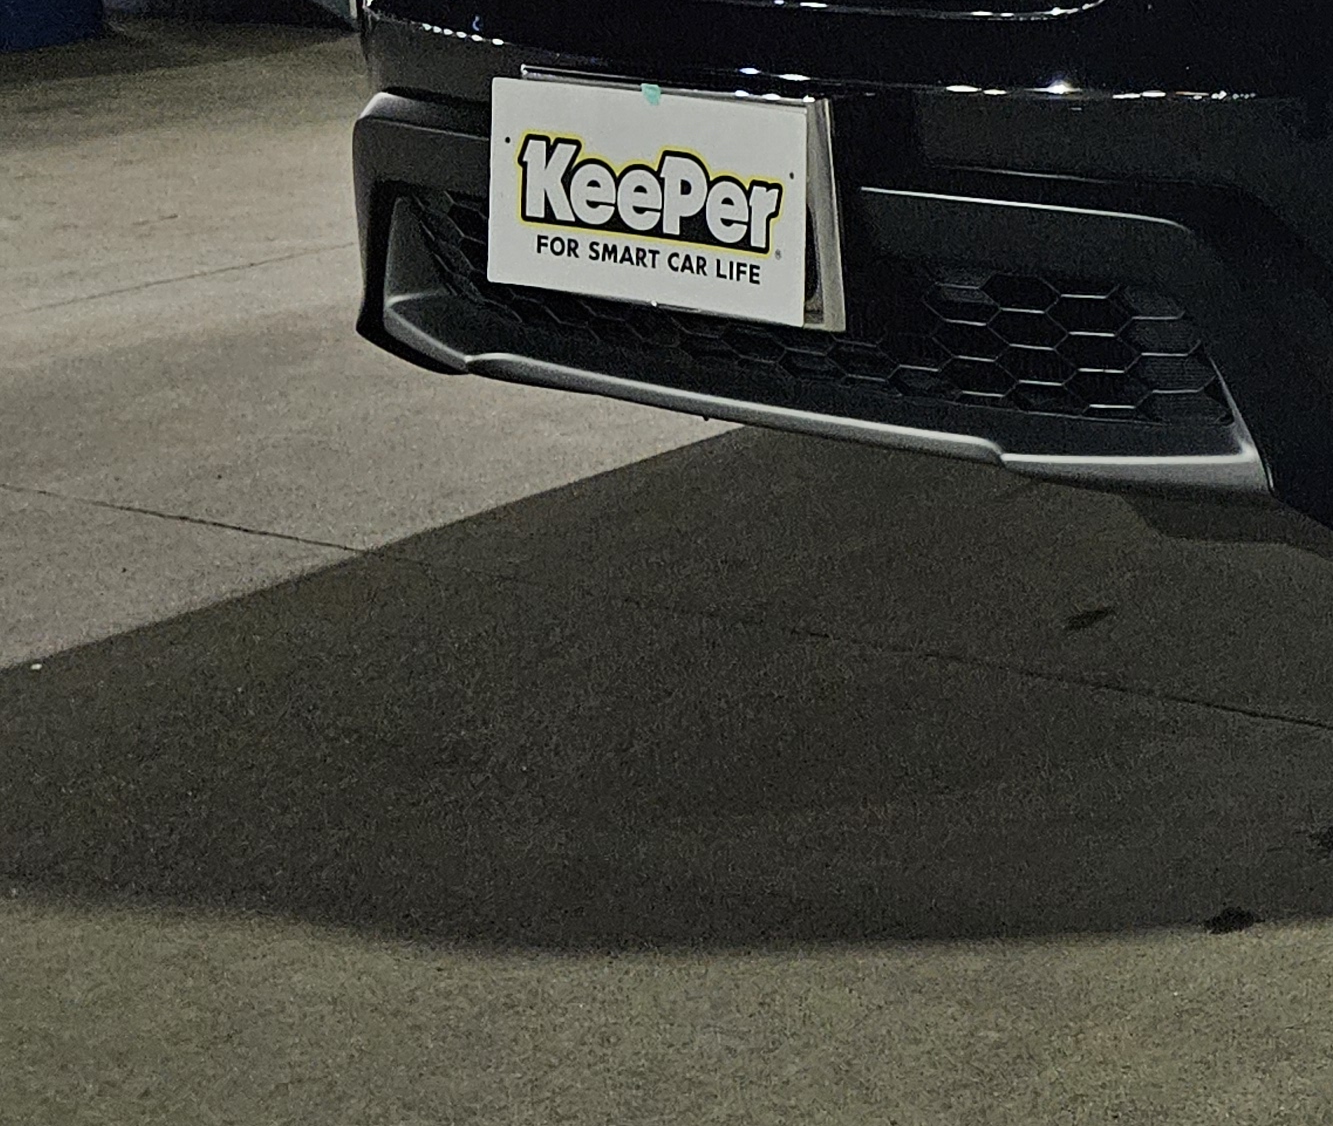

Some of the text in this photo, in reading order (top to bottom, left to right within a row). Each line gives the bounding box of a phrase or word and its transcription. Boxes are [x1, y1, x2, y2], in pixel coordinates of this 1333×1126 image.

[518, 134, 783, 255] KeePer
[536, 234, 762, 285] FOR SMART CAR LIFE
